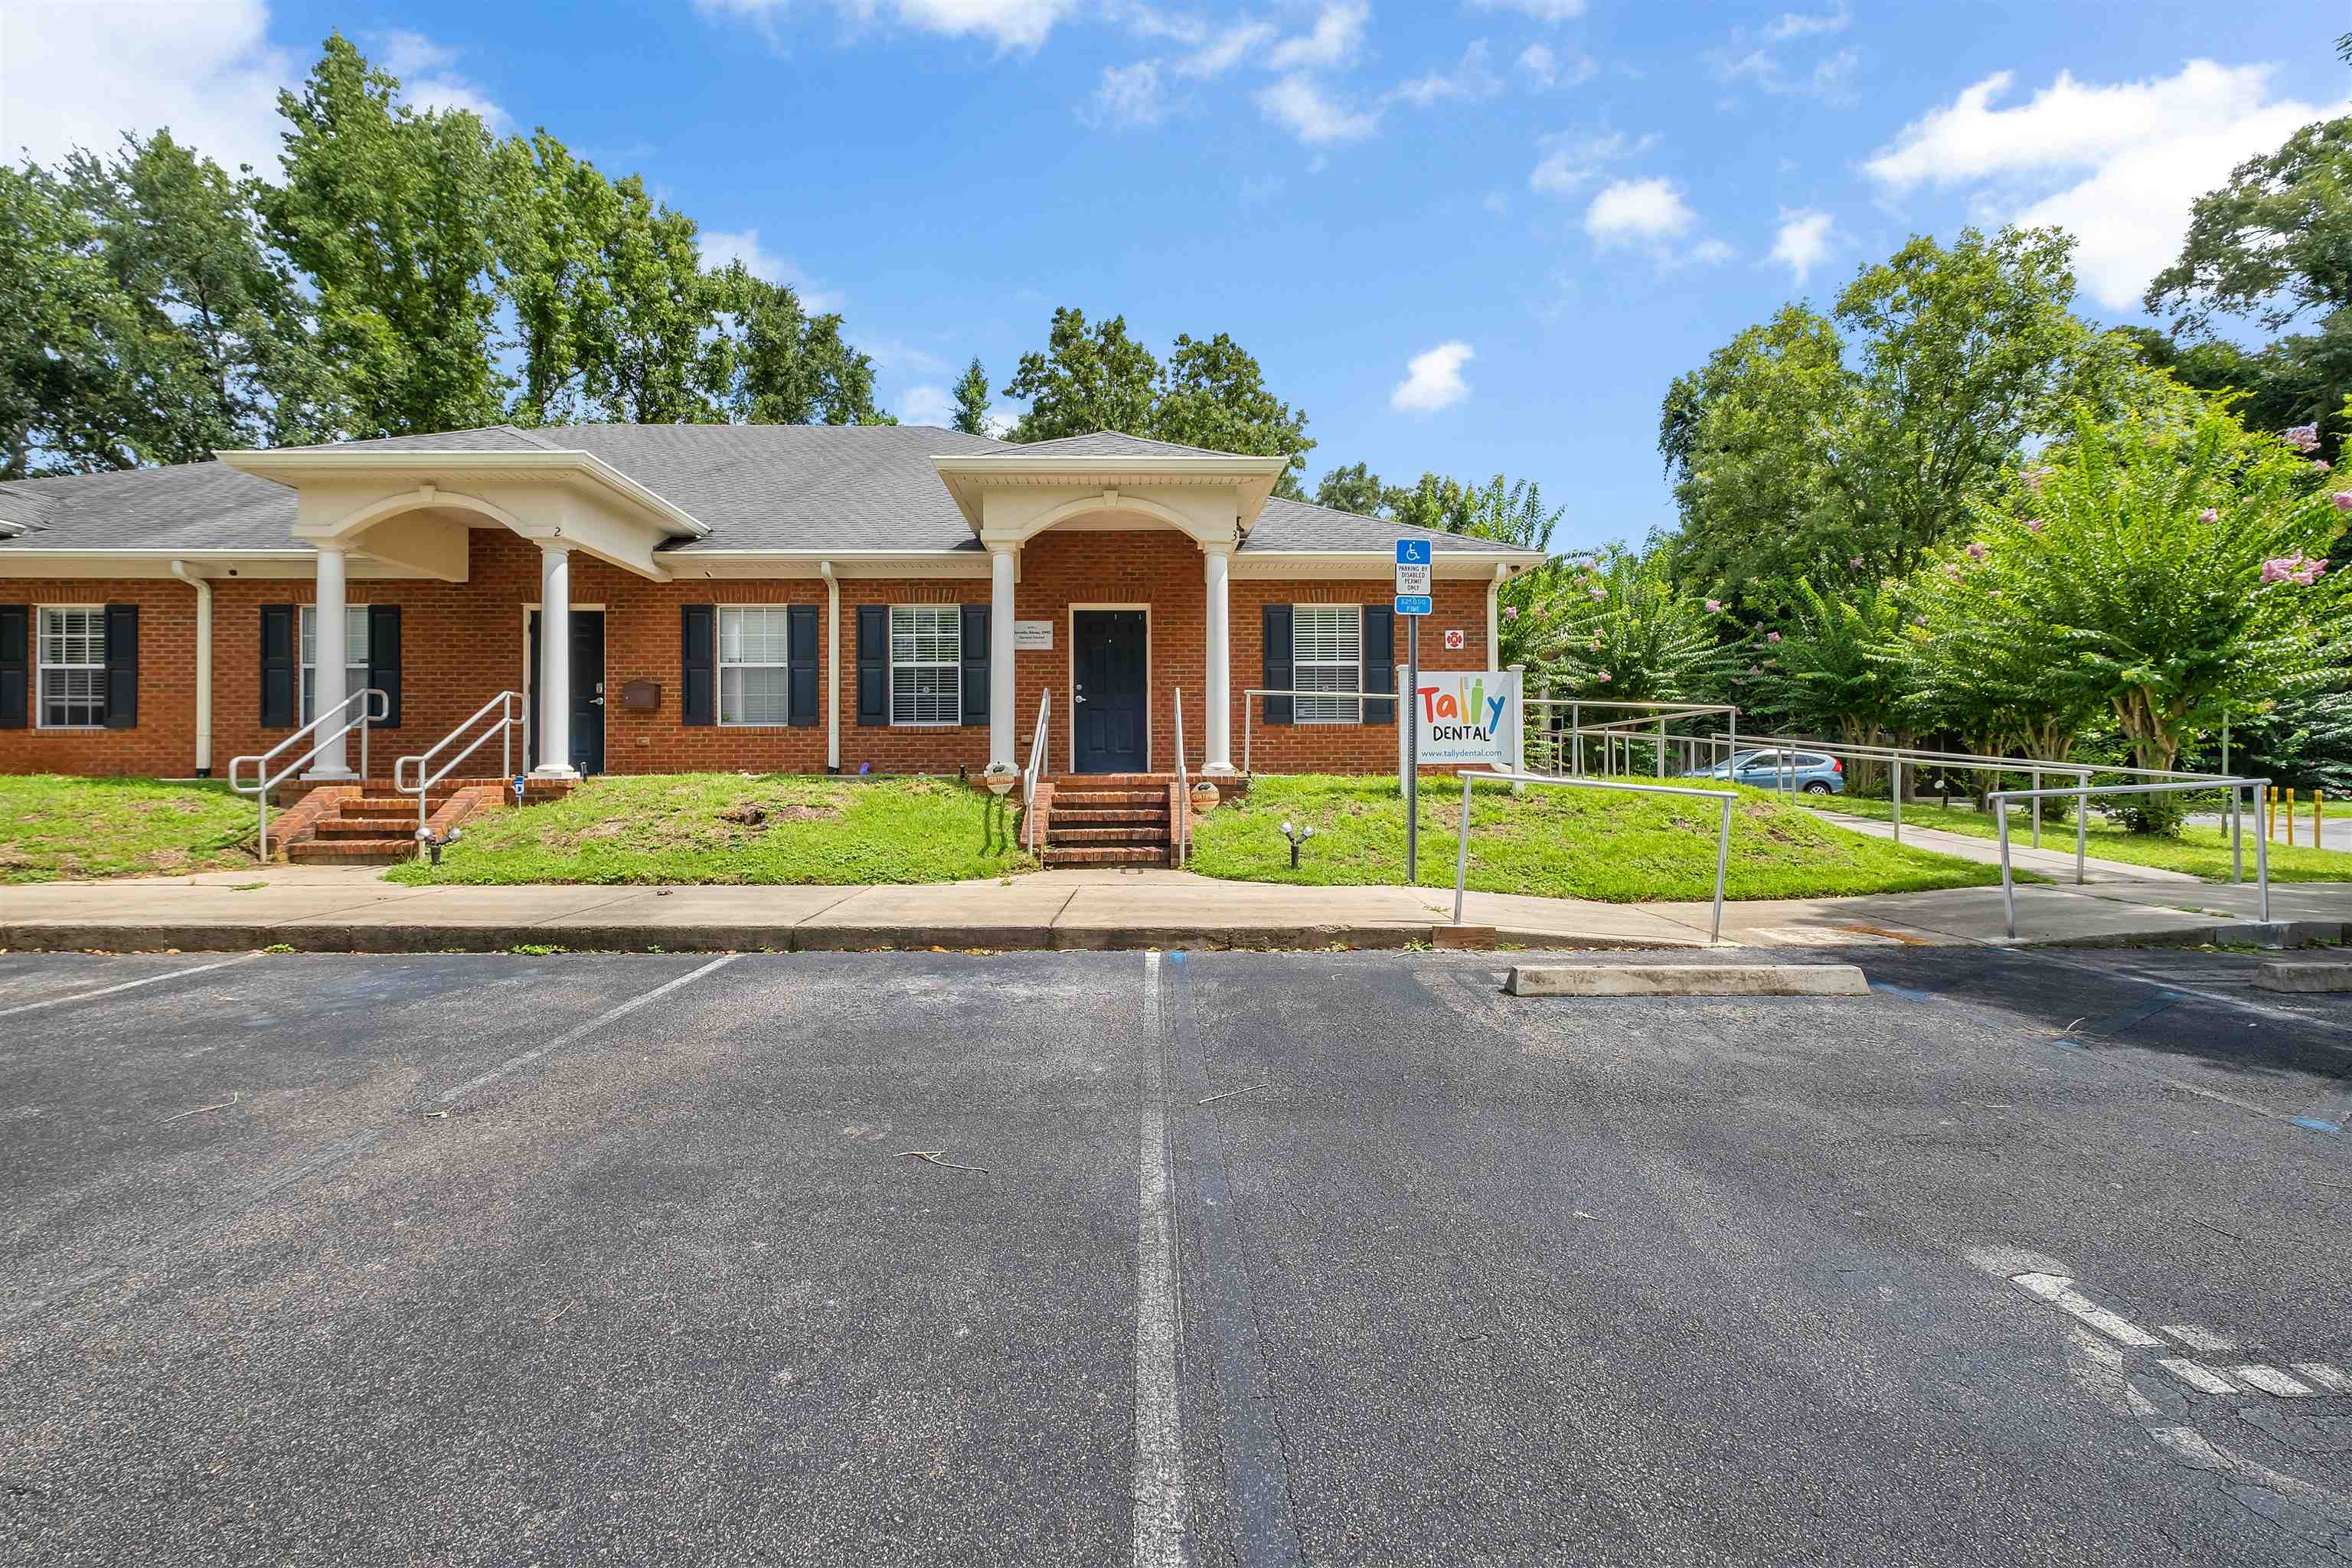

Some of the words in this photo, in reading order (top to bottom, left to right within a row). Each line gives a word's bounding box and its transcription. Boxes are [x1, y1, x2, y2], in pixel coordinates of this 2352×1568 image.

[554, 527, 561, 537] 2
[1231, 530, 1237, 541] 3
[1416, 674, 1506, 734] Tally
[1433, 726, 1491, 741] DENTAL
[1421, 749, 1501, 758] www.tallydental.com
